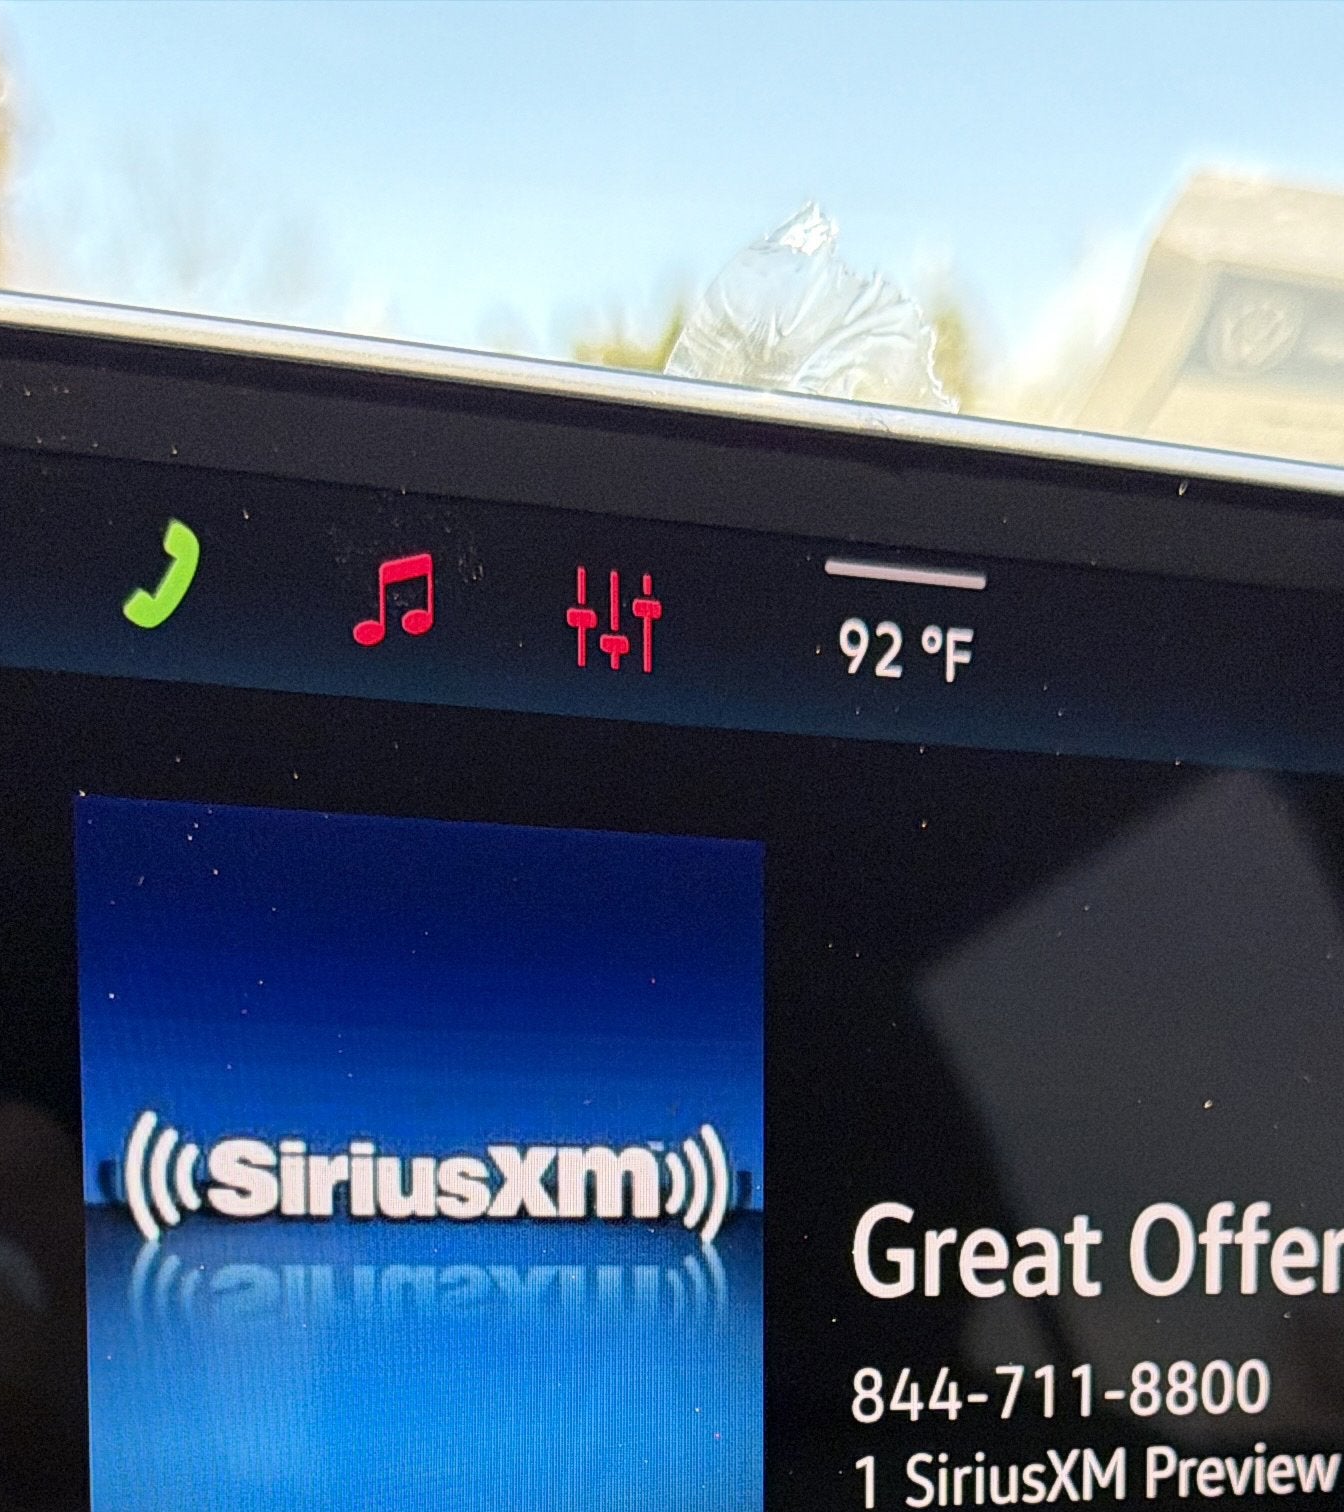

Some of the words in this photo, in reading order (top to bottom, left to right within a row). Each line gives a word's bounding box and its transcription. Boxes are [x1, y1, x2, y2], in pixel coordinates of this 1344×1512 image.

[840, 617, 903, 678] 92
[853, 1202, 1103, 1298] Great
[851, 1359, 1272, 1424] 844-711-8800
[855, 1455, 878, 1509] 1
[905, 1447, 1128, 1508] SiriusXM
[1146, 1443, 1342, 1499] Preview
